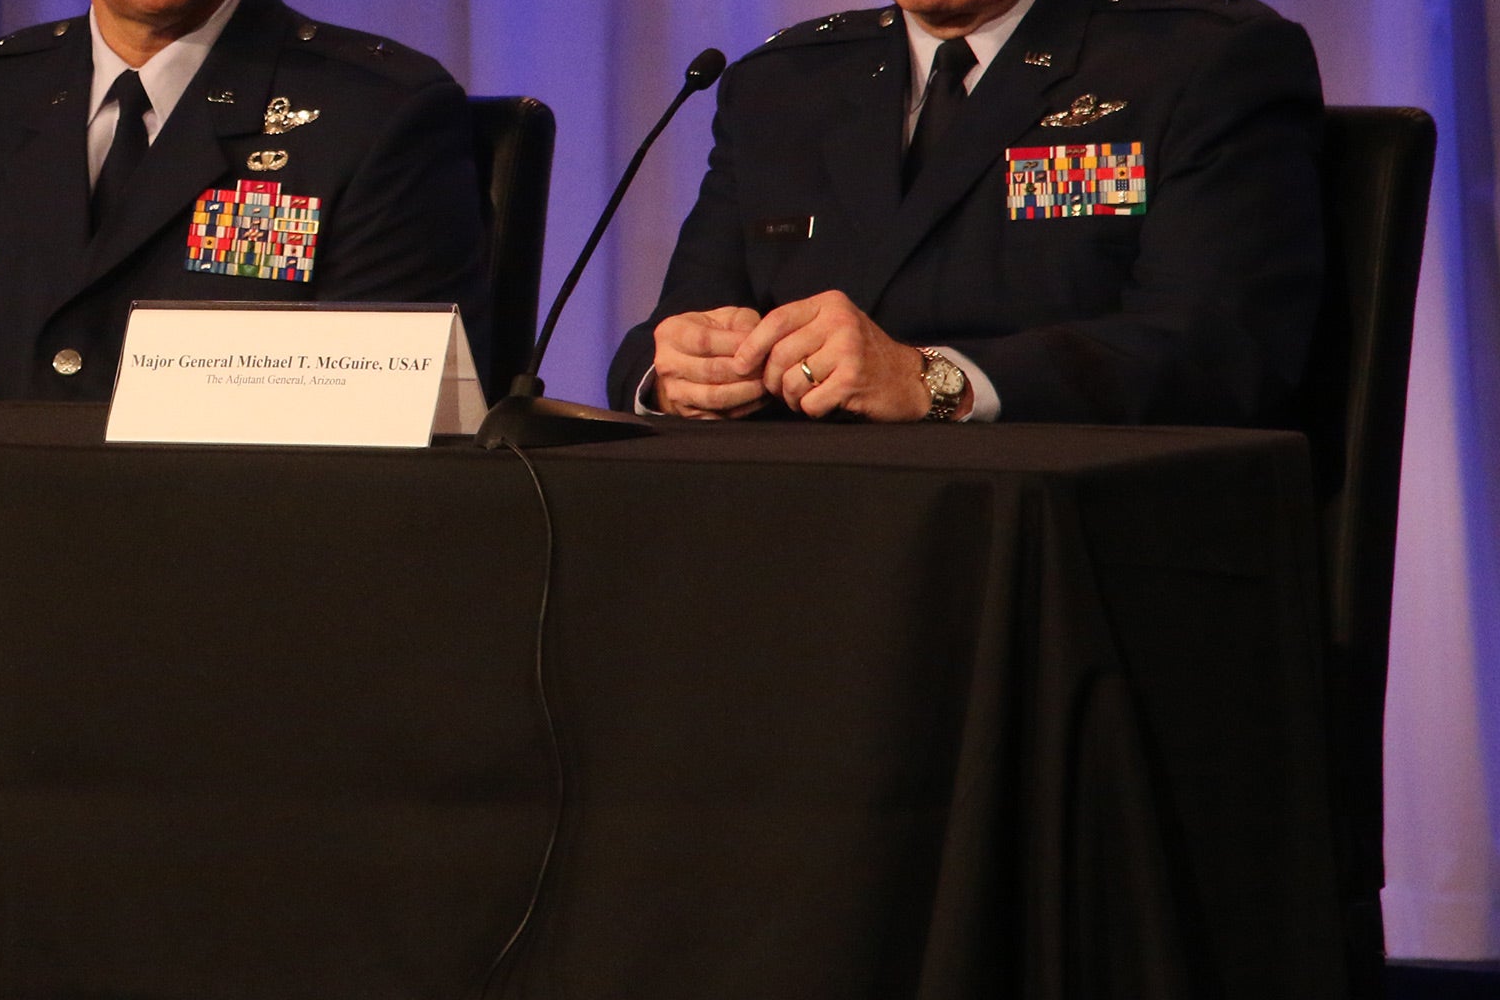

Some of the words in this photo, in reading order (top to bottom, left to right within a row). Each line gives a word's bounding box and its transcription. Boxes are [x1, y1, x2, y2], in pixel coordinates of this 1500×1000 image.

[132, 354, 175, 371] Major
[179, 354, 234, 368] General
[237, 355, 293, 369] Michael
[297, 356, 311, 369] T.
[316, 356, 383, 371] McGuire,
[388, 357, 432, 371] USAF
[206, 375, 224, 384] The
[226, 374, 266, 386] Adjutant
[267, 375, 307, 386] General,
[309, 376, 347, 386] Arizona
